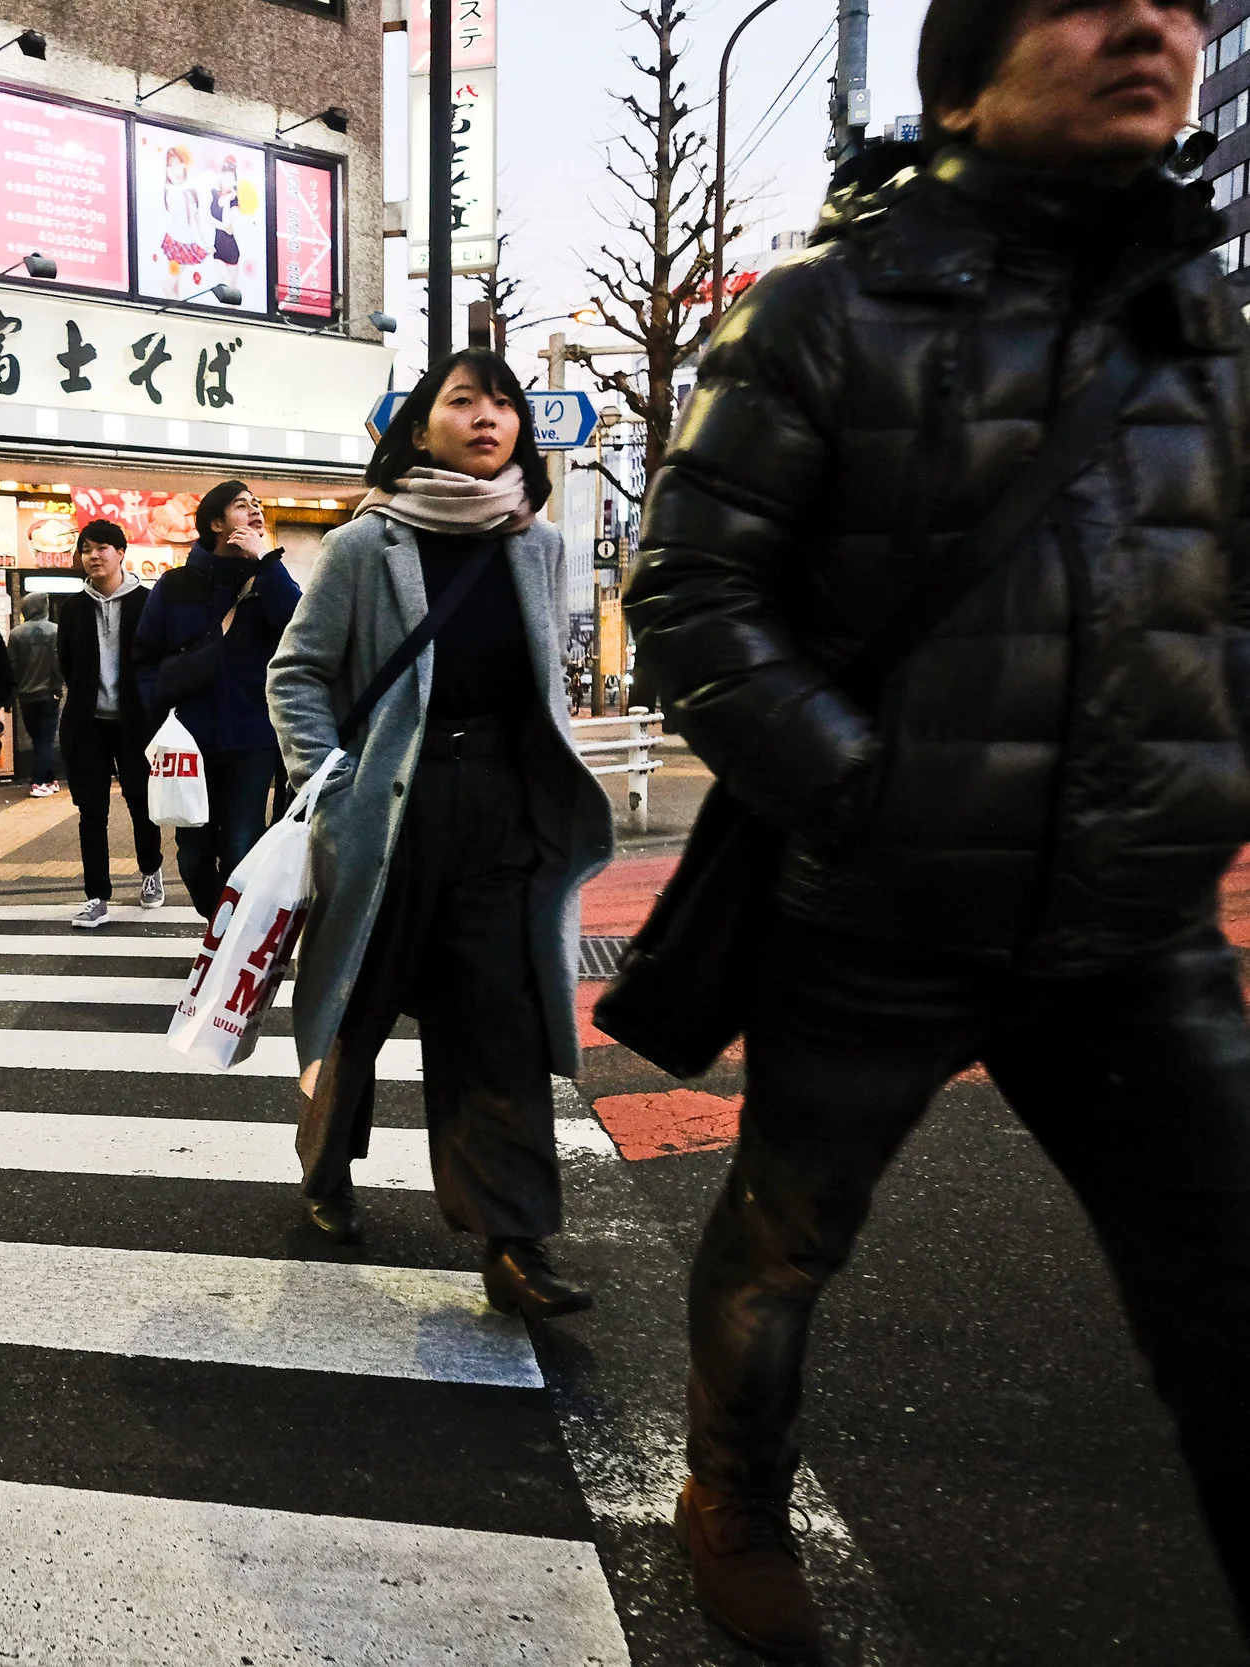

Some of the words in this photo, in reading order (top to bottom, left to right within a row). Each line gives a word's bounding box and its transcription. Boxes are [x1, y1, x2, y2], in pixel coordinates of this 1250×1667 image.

[534, 427, 560, 440] Ave.
[75, 488, 148, 532] かつ丼
